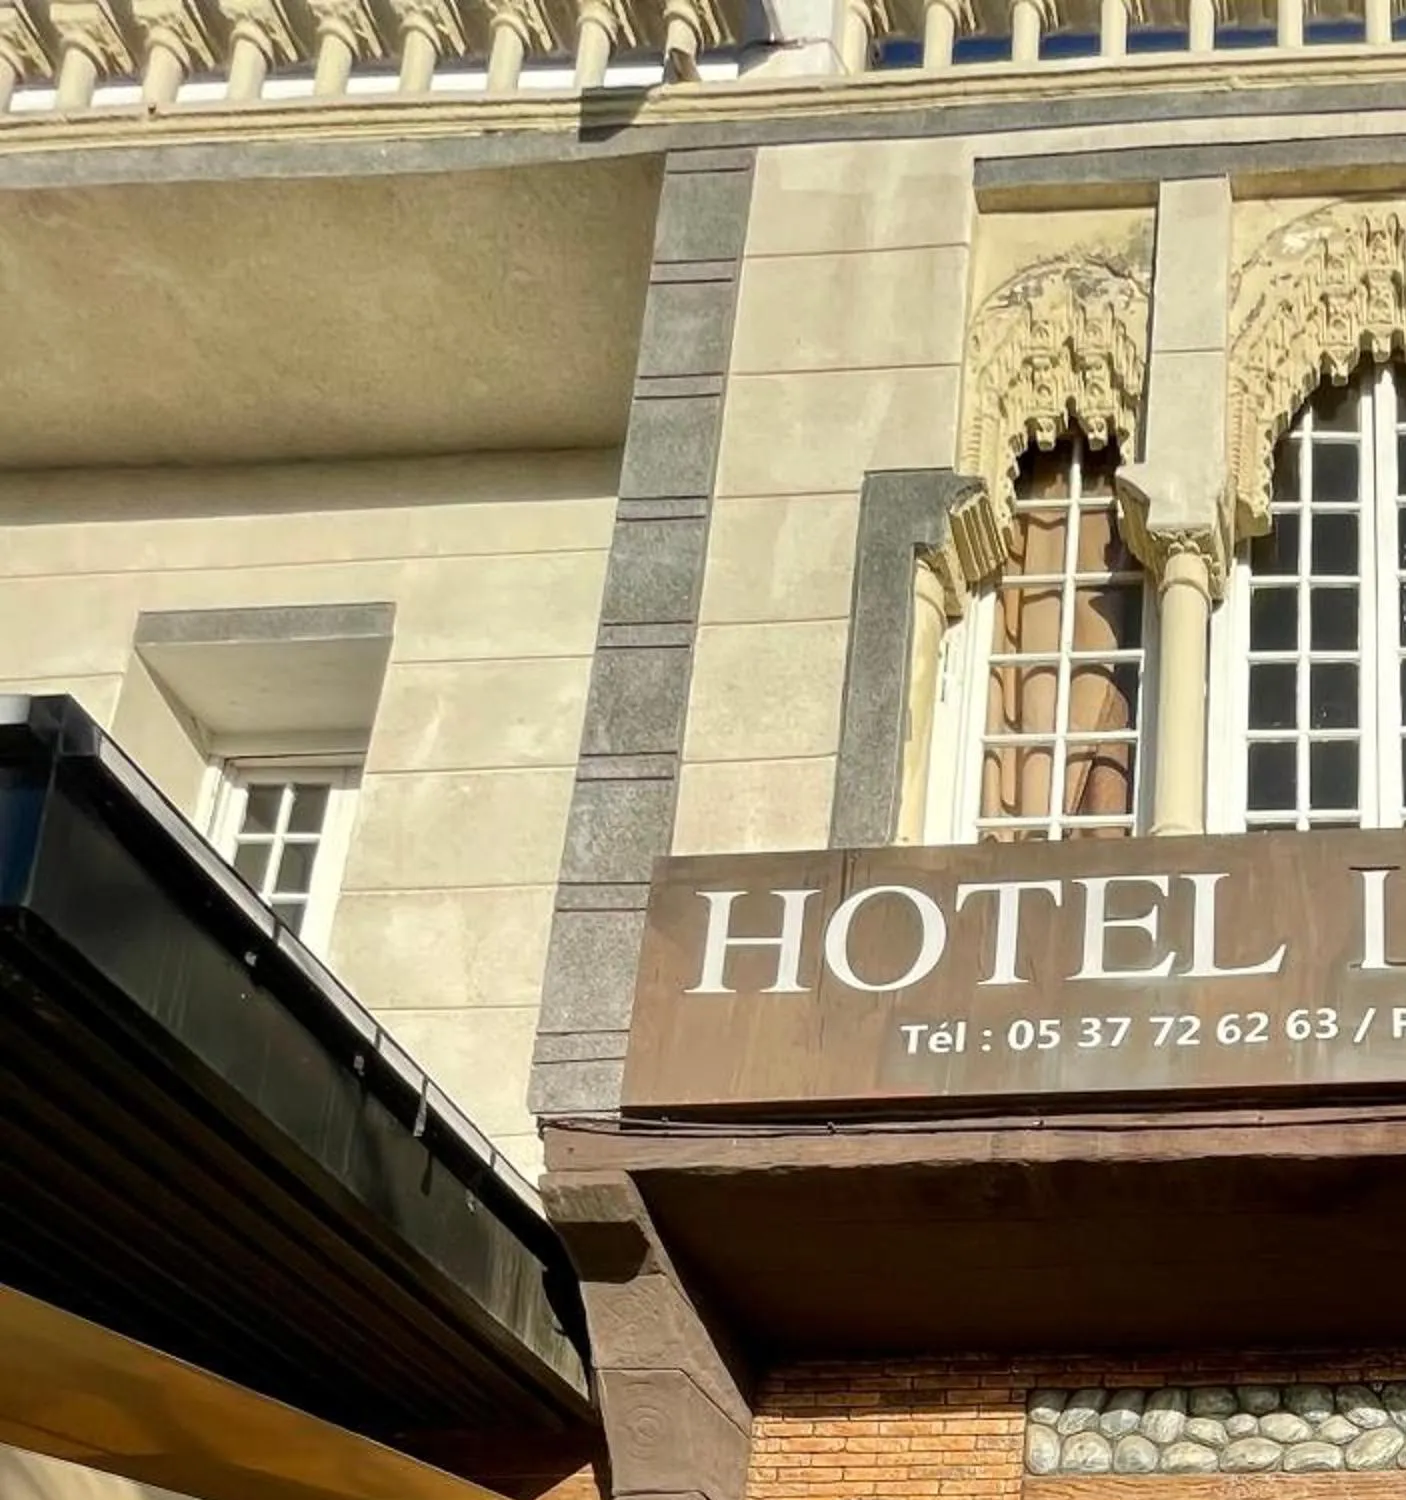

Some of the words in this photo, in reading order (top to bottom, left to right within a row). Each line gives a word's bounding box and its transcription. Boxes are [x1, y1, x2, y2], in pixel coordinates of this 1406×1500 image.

[684, 872, 1286, 994] HOTEL
[900, 1021, 967, 1054] Tél
[1007, 1018, 1061, 1051] 05
[1077, 1017, 1132, 1048] 37
[1149, 1015, 1201, 1047] 72
[1216, 1012, 1270, 1045] 62
[1286, 1007, 1339, 1041] 63
